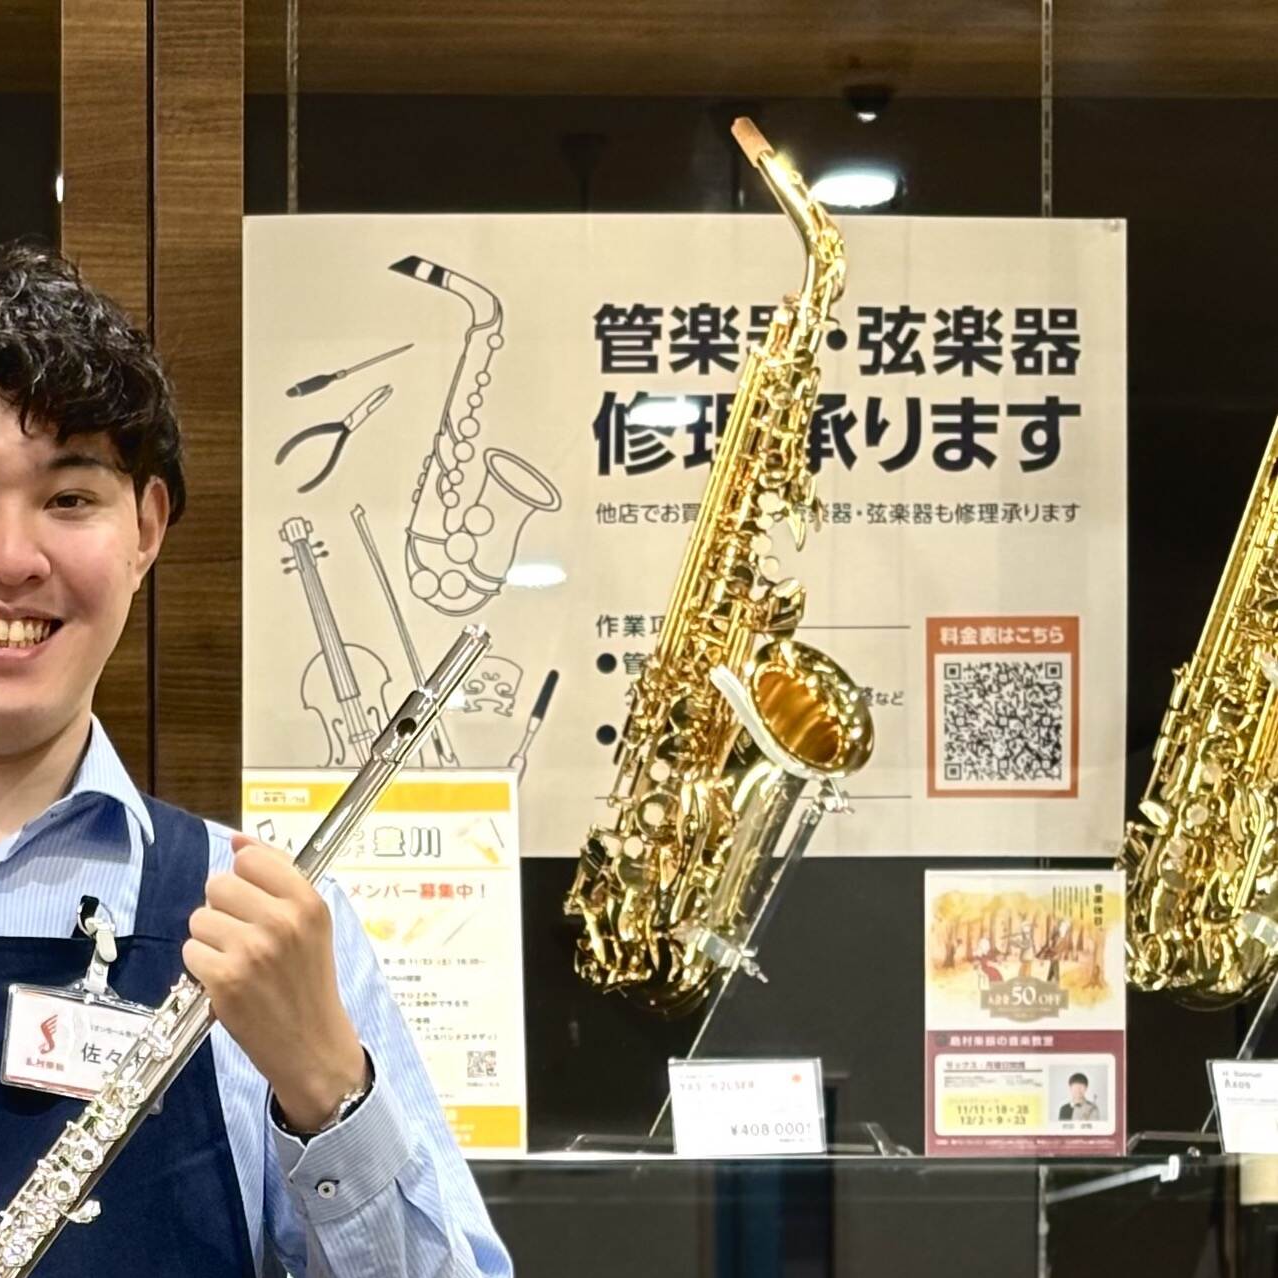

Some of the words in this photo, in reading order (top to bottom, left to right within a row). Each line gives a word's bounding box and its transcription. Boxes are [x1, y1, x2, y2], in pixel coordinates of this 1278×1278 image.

[940, 625, 1065, 646] 料金表はこちら
